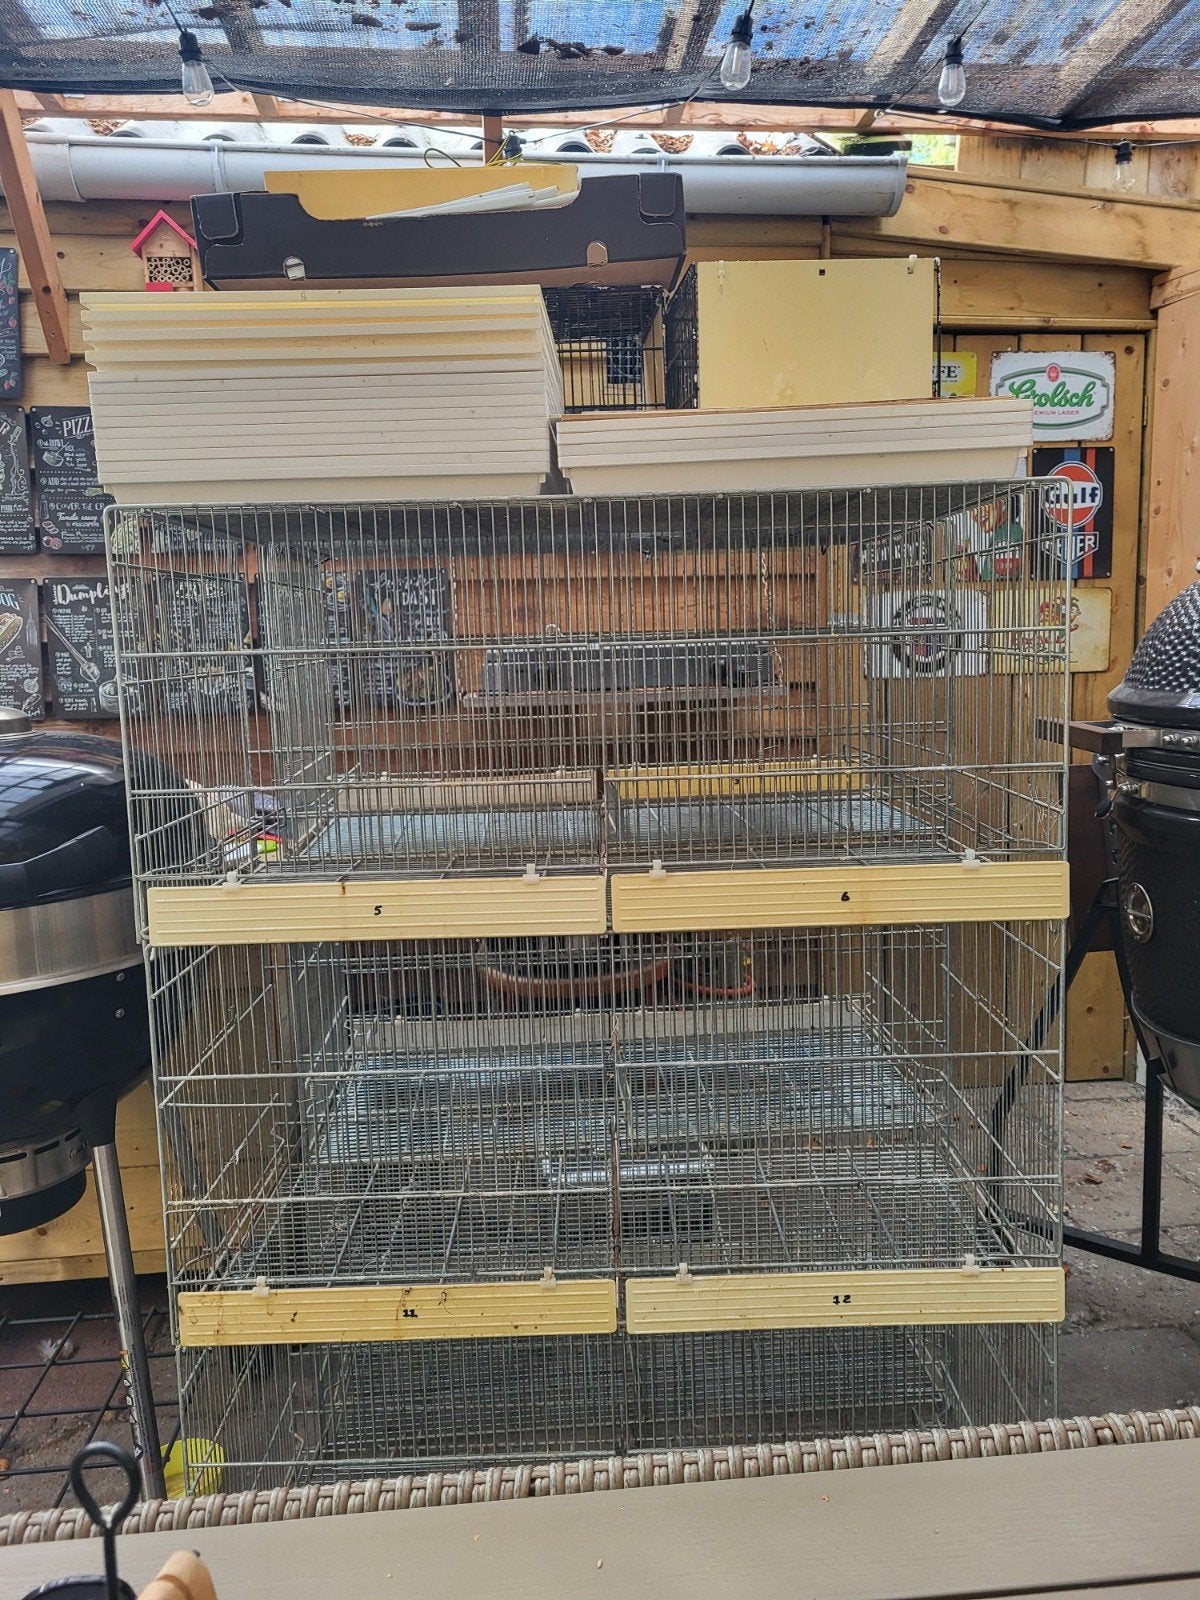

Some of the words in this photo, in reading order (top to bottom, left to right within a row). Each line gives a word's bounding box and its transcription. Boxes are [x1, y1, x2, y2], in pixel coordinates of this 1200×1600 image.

[62, 416, 94, 438] PIZZ
[1046, 486, 1099, 504] Gulf
[840, 891, 851, 902] 6
[374, 905, 383, 916] 5
[832, 1294, 852, 1305] 12
[402, 1308, 419, 1318] 11
